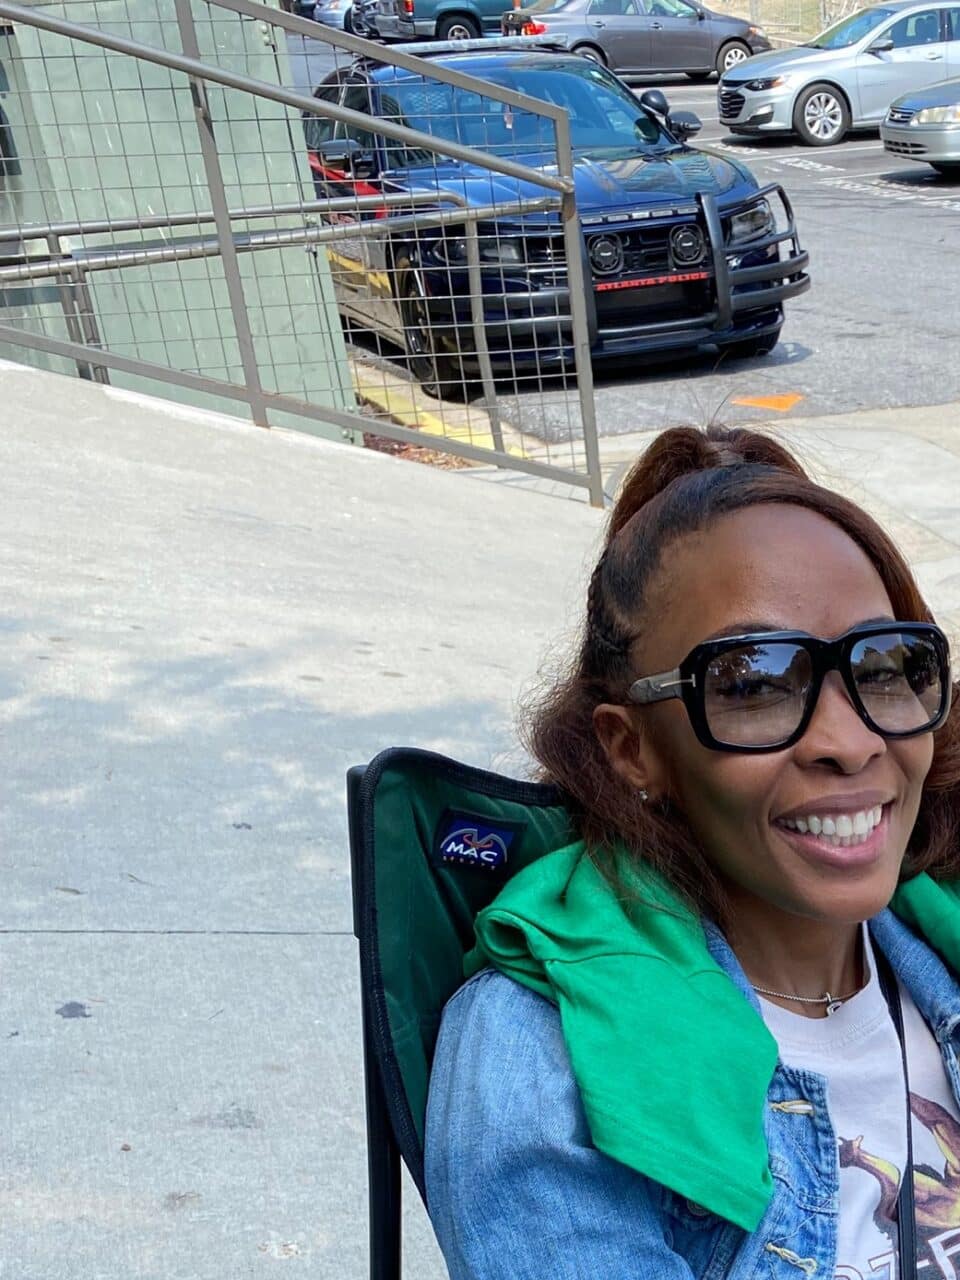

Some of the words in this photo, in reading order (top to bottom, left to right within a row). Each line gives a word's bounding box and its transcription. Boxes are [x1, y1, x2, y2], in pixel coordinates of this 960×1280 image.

[595, 279, 656, 292] ATLANTA
[658, 271, 709, 284] POLICE
[446, 841, 498, 862] MAC
